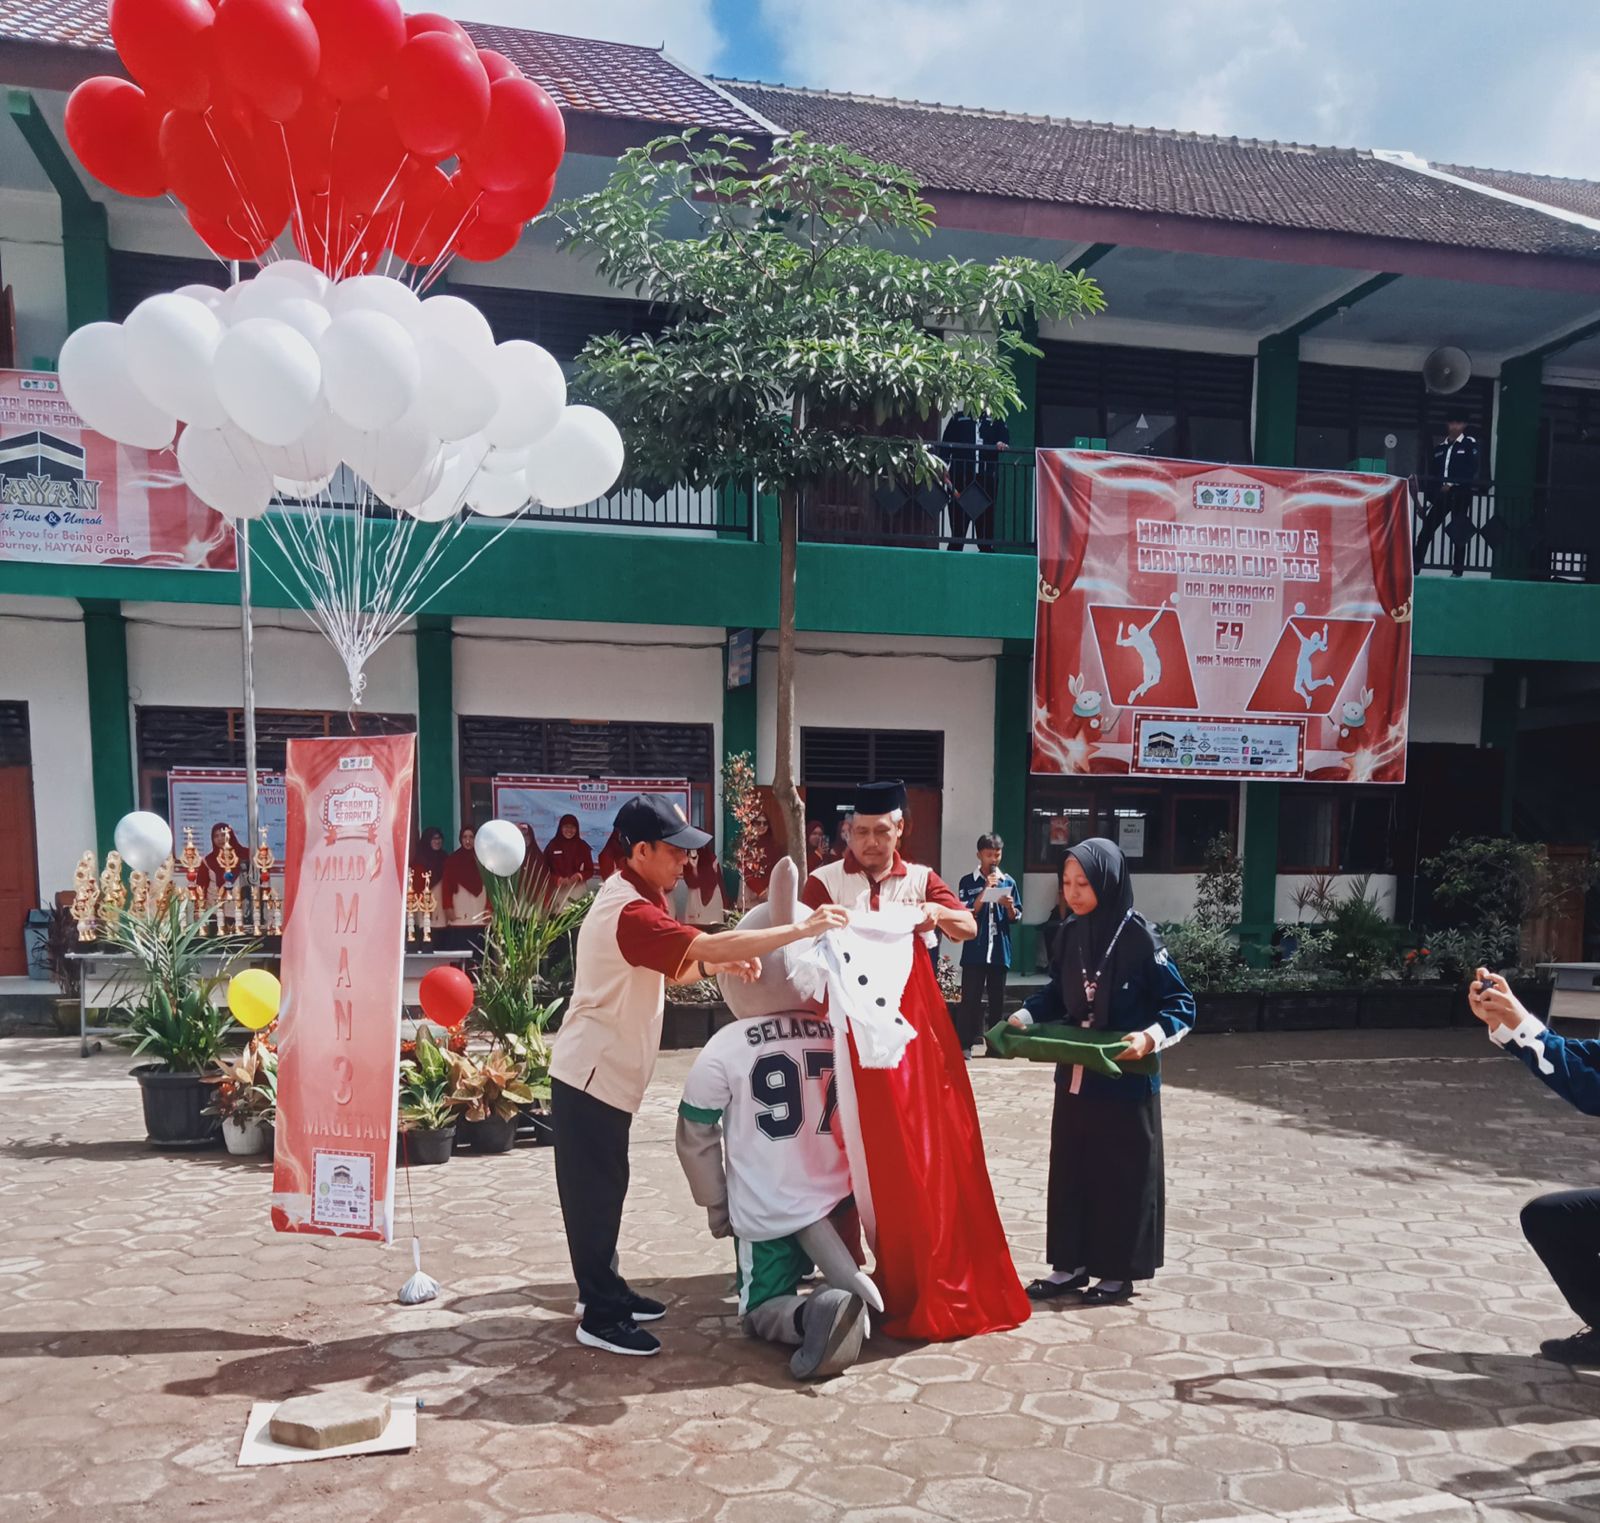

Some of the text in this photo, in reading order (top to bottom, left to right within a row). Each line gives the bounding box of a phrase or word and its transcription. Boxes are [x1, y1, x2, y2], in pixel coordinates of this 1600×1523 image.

[13, 508, 40, 522] Plus
[63, 511, 103, 525] Umroh
[18, 529, 39, 541] you
[43, 529, 59, 539] for
[62, 530, 93, 543] Being
[106, 532, 130, 544] Part
[45, 542, 92, 553] HAYYAN
[95, 545, 134, 557] Group.
[1137, 519, 1319, 554] MANTIGMA CUP IV &
[1138, 548, 1319, 581] MANTIGMA CUP III
[1185, 582, 1275, 601] DALAM RANGKA
[1211, 601, 1252, 617] MILAD
[1215, 621, 1244, 651] 29
[1215, 654, 1221, 666] 3
[1223, 656, 1261, 669] MAGETAN
[314, 855, 366, 881] MILAD
[333, 1056, 353, 1106] 3
[749, 1048, 837, 1141] 97
[303, 1114, 387, 1140] MAGETAN
